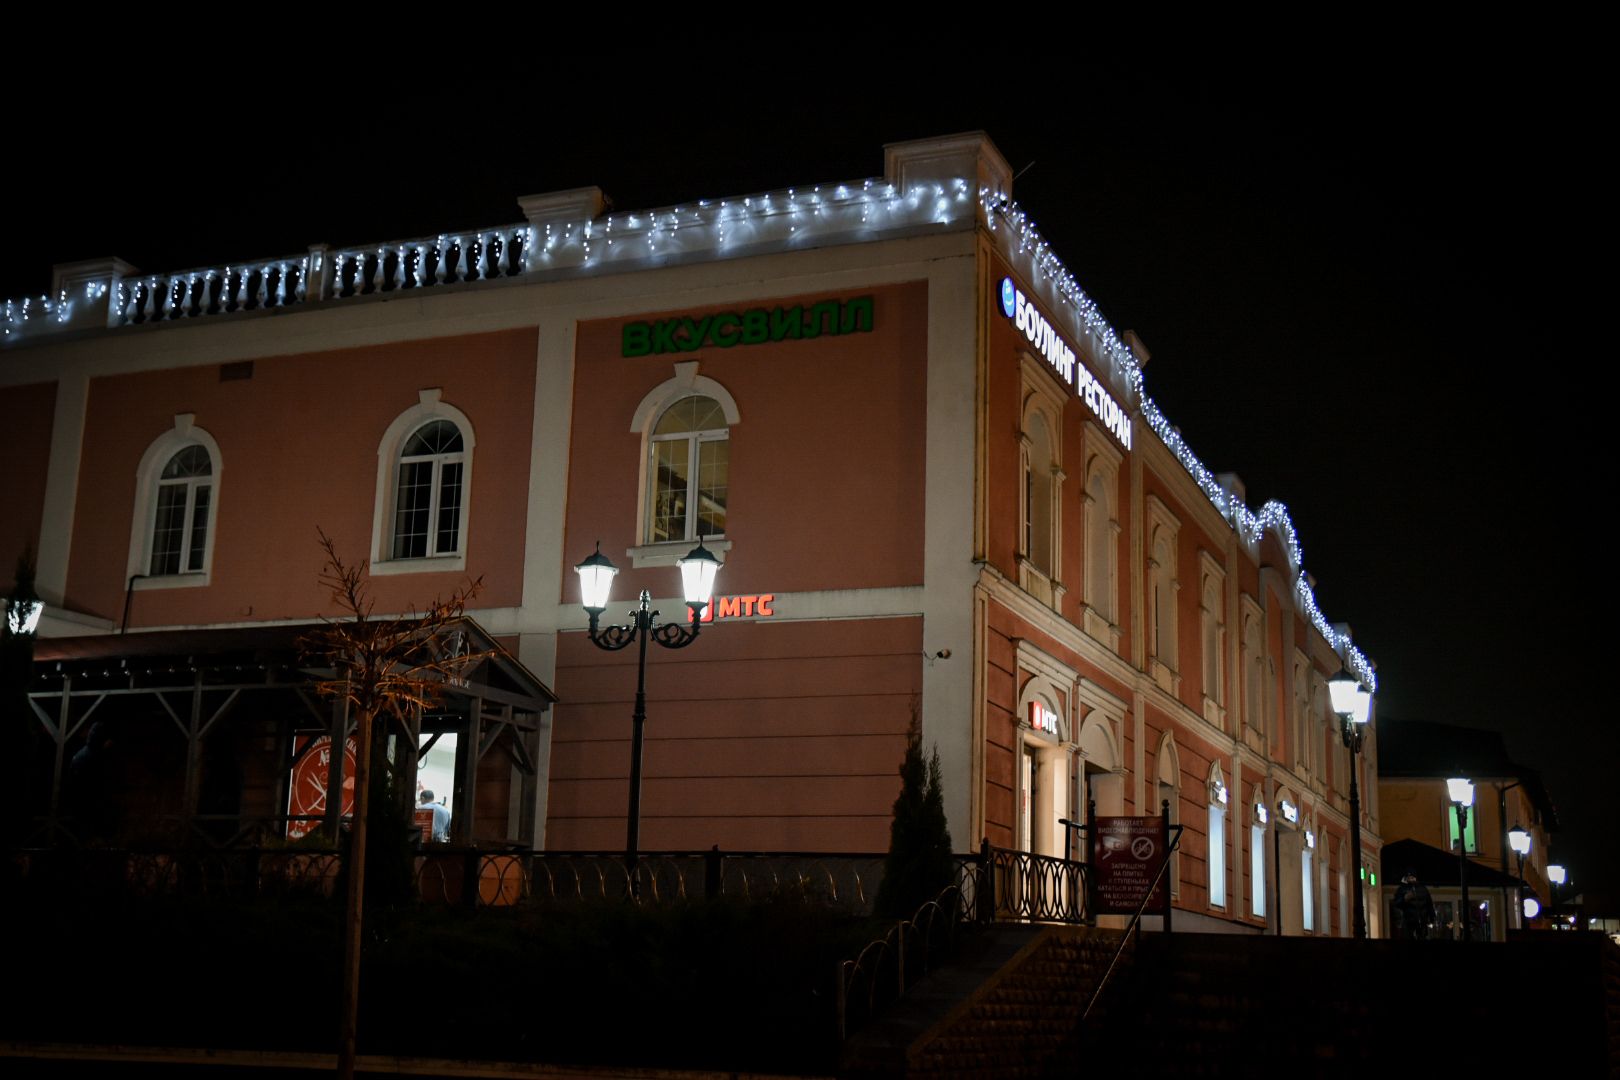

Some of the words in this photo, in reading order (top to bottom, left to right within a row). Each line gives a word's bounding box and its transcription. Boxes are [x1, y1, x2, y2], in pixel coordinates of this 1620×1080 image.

[622, 295, 874, 357] ВКУСВИЛЛ
[1015, 290, 1076, 385] БОУЛИНГ
[1077, 361, 1132, 451] РЕСТОРАН
[718, 593, 774, 618] МТС
[1111, 862, 1146, 870] ЗАПРЕЩЕНО
